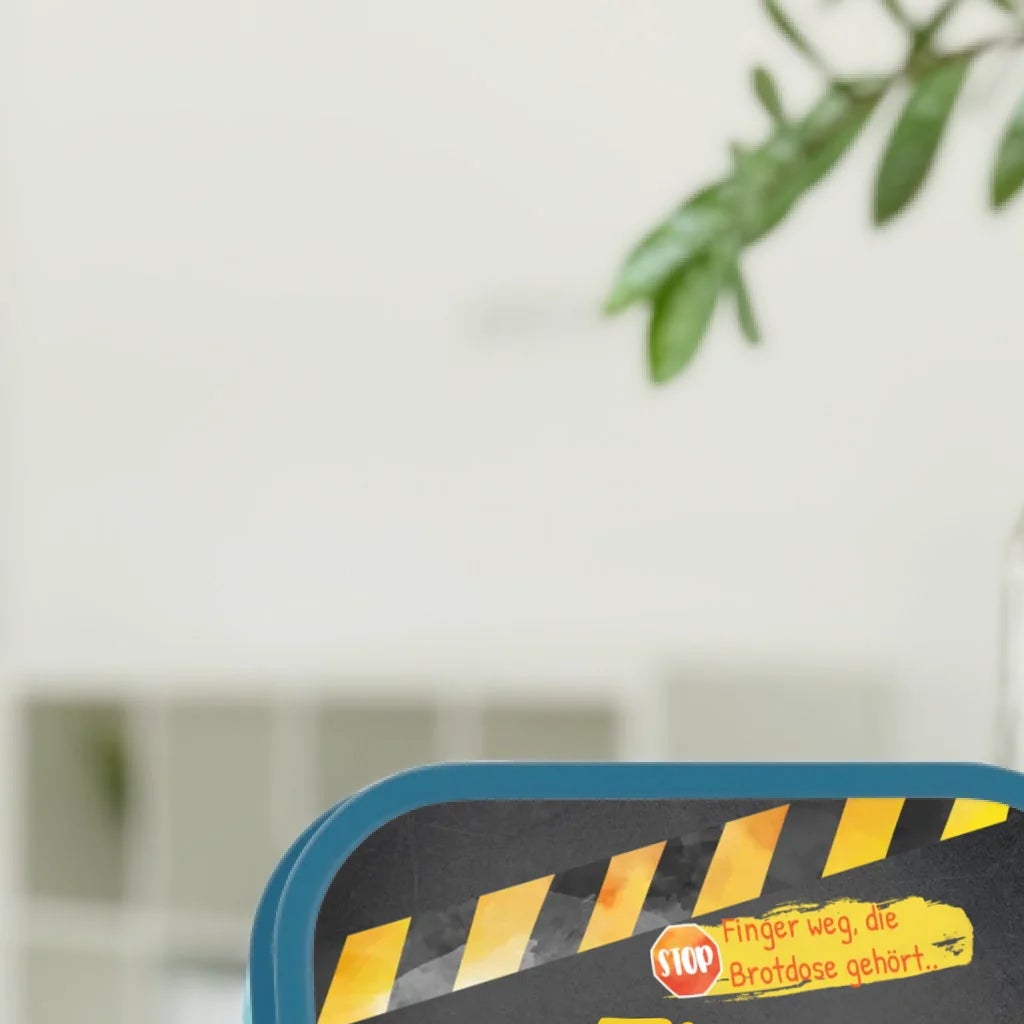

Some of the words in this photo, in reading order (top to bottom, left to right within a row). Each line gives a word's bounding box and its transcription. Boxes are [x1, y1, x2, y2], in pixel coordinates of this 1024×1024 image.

[721, 917, 799, 950] Finger
[807, 915, 858, 944] weg,
[866, 904, 899, 931] die
[657, 944, 714, 978] STOP
[729, 955, 838, 988] Brotdose
